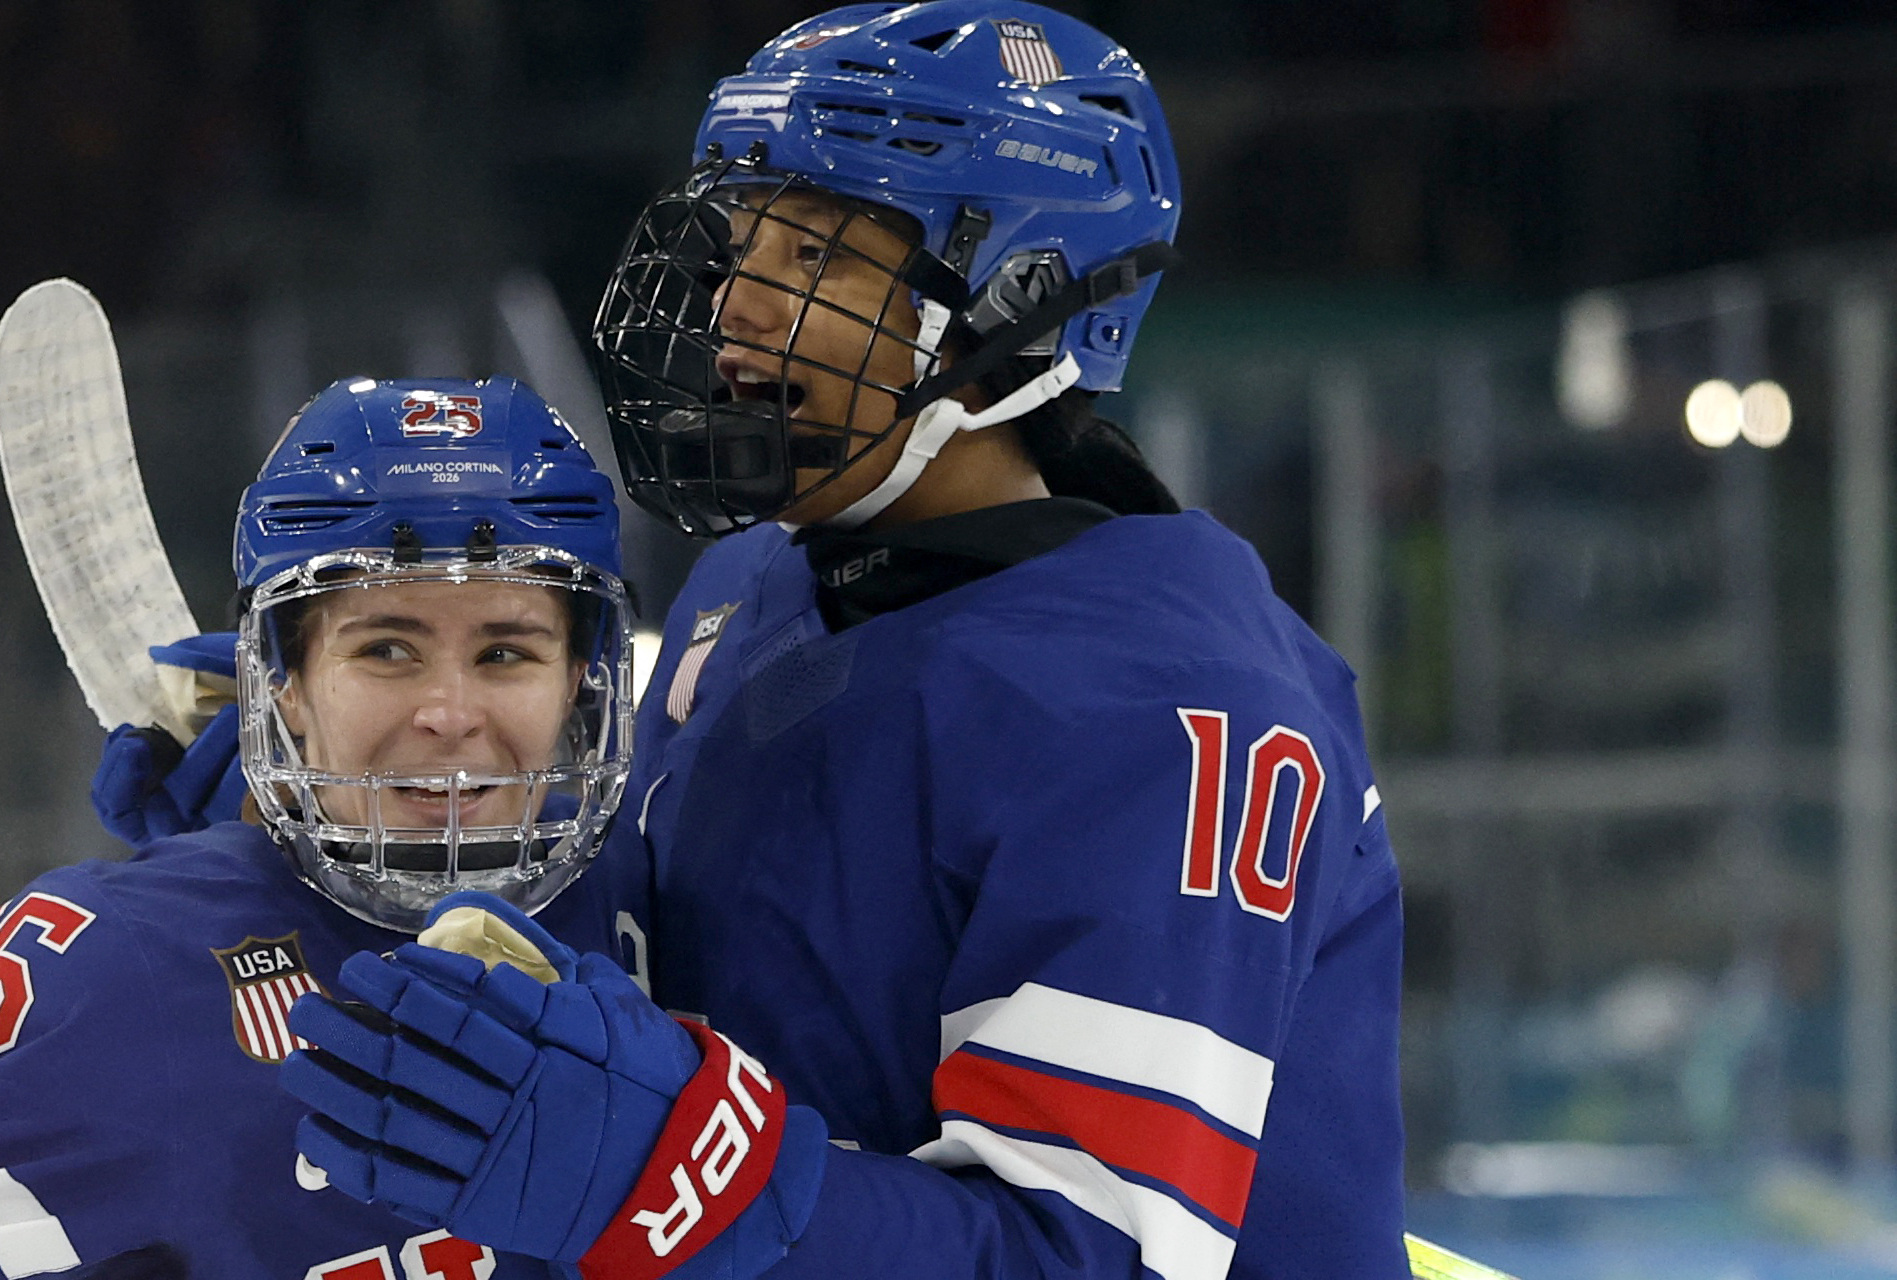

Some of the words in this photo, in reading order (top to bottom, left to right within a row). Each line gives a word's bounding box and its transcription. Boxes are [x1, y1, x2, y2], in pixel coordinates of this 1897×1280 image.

[1001, 23, 1038, 40] USA
[995, 138, 1099, 179] BAUER
[401, 390, 484, 439] 25
[386, 463, 444, 476] MILANO
[445, 462, 504, 475] CORTINA
[431, 473, 460, 483] 2026
[1177, 706, 1326, 922] 10
[232, 946, 295, 979] USA
